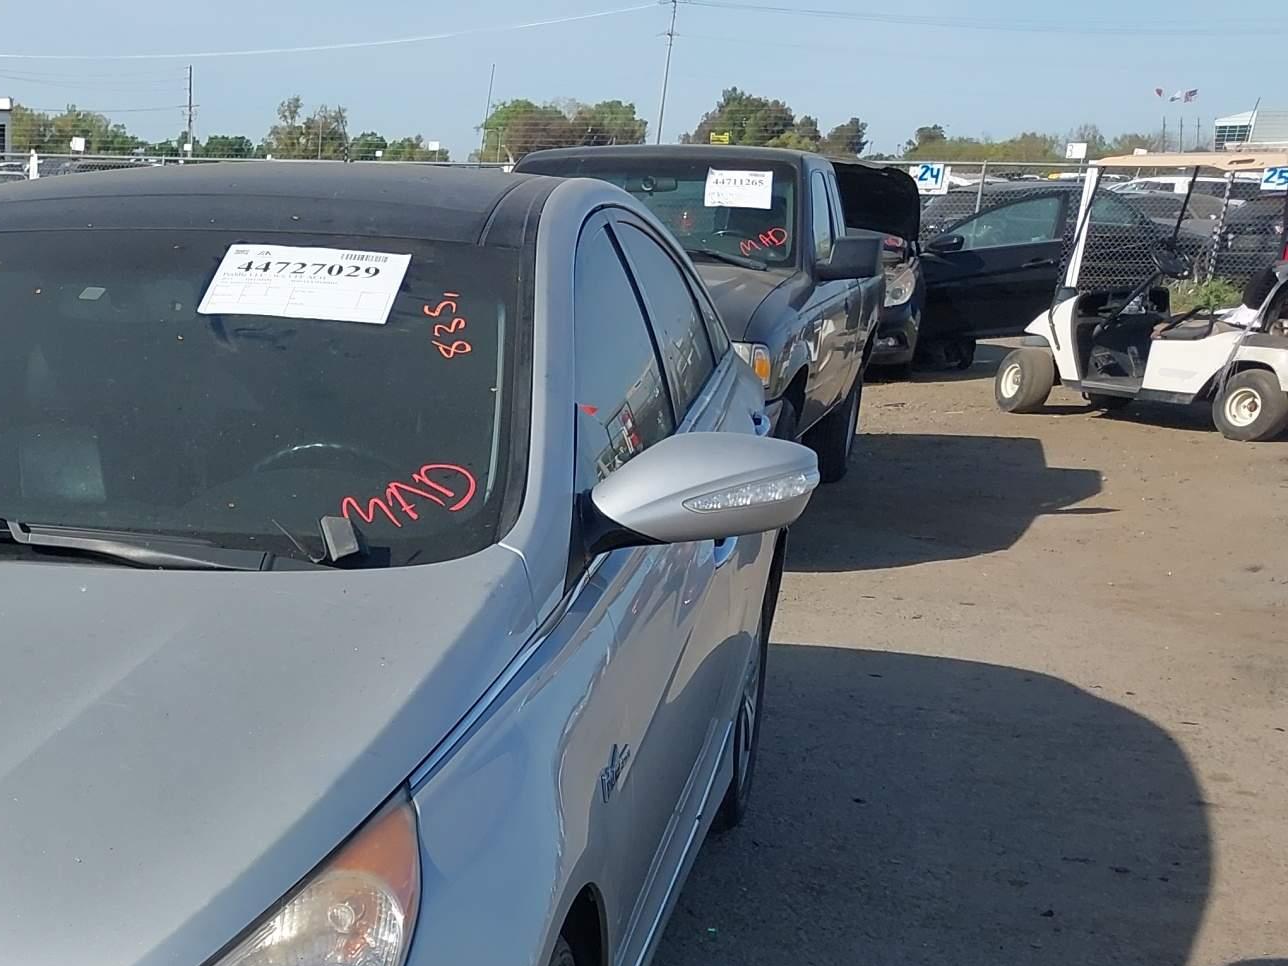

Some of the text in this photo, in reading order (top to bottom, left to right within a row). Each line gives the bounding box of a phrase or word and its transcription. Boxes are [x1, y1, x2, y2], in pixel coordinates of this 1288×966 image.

[713, 178, 765, 187] 44711265
[918, 165, 941, 185] 24
[1263, 167, 1288, 186] 25
[739, 227, 788, 256] MAD
[237, 260, 381, 278] 44727029
[342, 463, 477, 528] MAD
